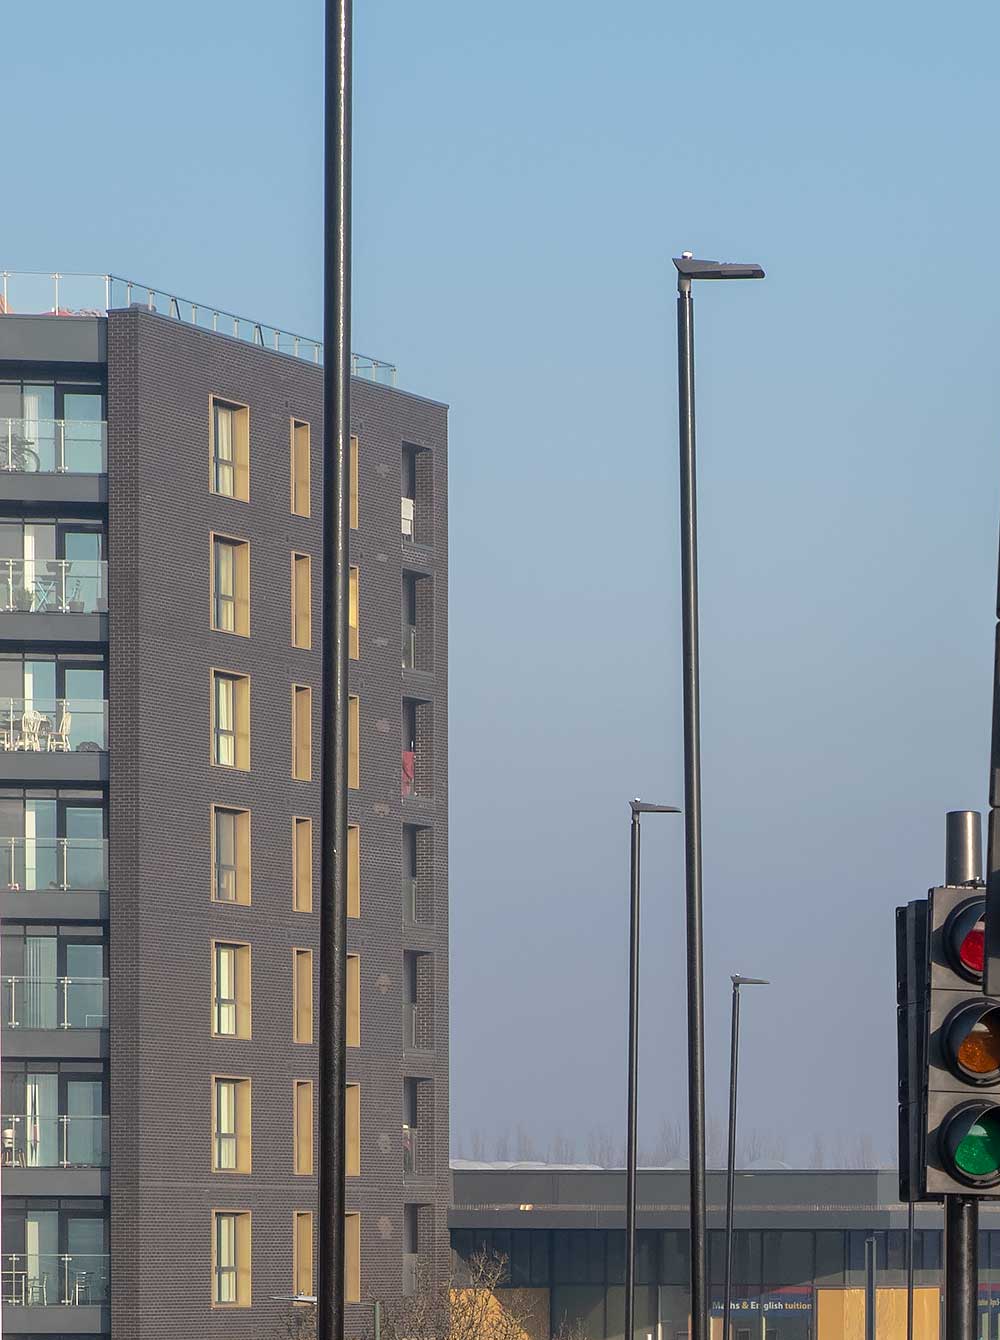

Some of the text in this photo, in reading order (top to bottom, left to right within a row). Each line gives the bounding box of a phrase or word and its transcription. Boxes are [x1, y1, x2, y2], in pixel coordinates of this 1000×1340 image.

[712, 1301, 740, 1310] Mahs
[741, 1301, 749, 1310] &
[784, 1301, 812, 1310] tuition
